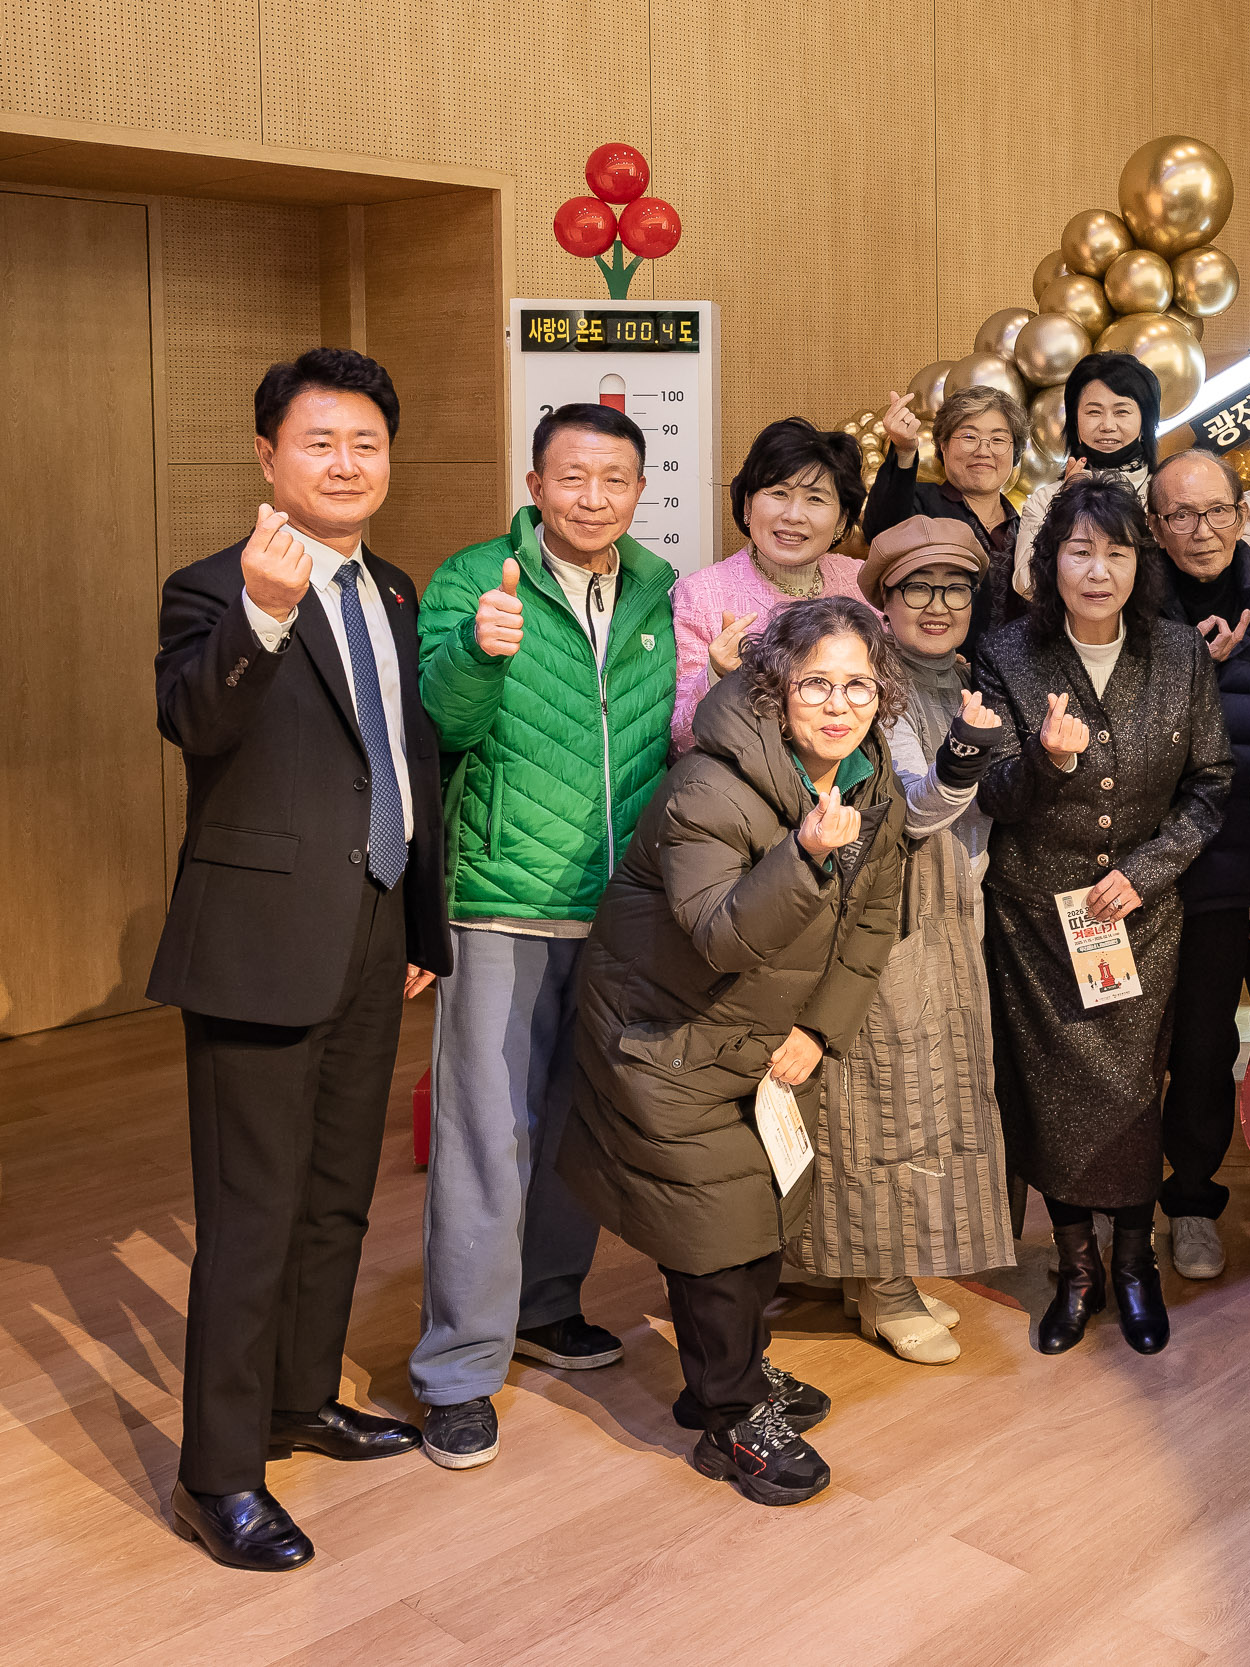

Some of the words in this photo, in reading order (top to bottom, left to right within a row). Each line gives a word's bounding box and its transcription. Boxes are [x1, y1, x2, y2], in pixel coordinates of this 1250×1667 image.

[528, 317, 570, 343] 사랑의
[575, 318, 603, 343] 온도
[660, 391, 684, 402] 100
[662, 424, 679, 435] 90
[663, 461, 679, 472] 80
[663, 497, 679, 508] 70
[663, 533, 679, 544] 60
[1067, 908, 1084, 917] 2026
[1068, 915, 1110, 930] 따뜻
